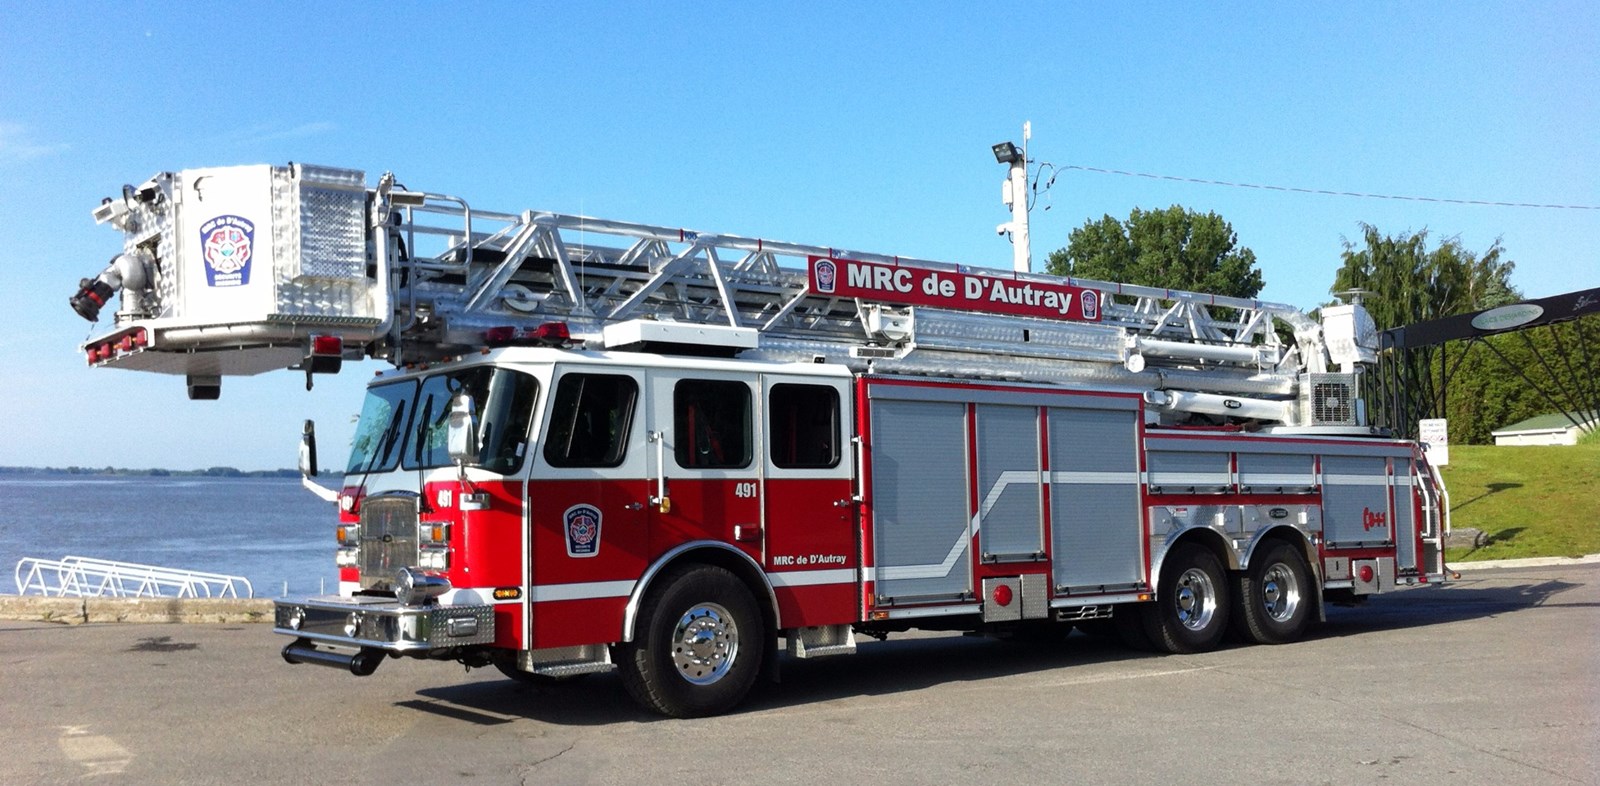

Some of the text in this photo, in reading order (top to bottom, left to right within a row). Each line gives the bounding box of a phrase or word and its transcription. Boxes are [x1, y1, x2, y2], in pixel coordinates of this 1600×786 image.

[847, 263, 1073, 315] MRC de D'Autray
[735, 482, 757, 498] 491
[438, 490, 453, 508] 491
[773, 553, 847, 566] MRC de D'Autray
